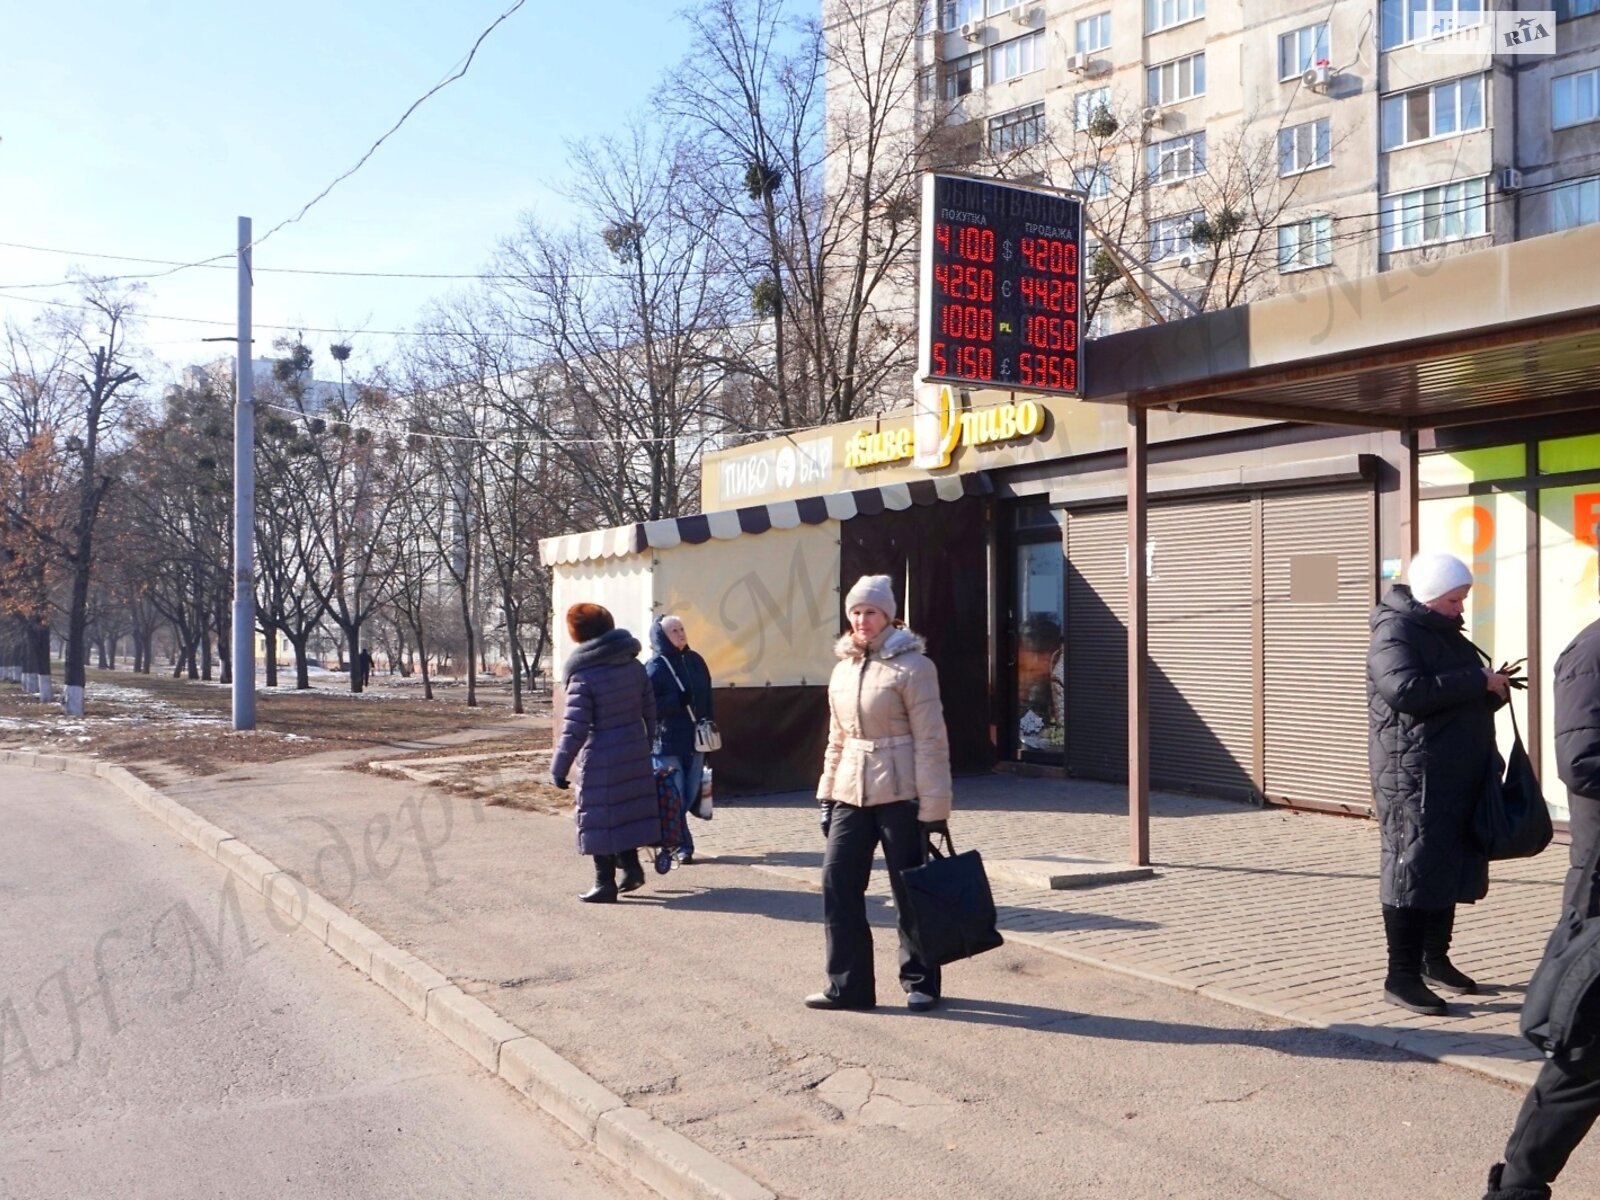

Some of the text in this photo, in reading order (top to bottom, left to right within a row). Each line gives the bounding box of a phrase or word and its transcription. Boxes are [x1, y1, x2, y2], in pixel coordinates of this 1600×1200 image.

[941, 208, 987, 226] ПОКУПКА
[1025, 222, 1073, 240] ПРОДАЖА
[1000, 322, 1012, 333] PL
[724, 455, 769, 496] ПИВО
